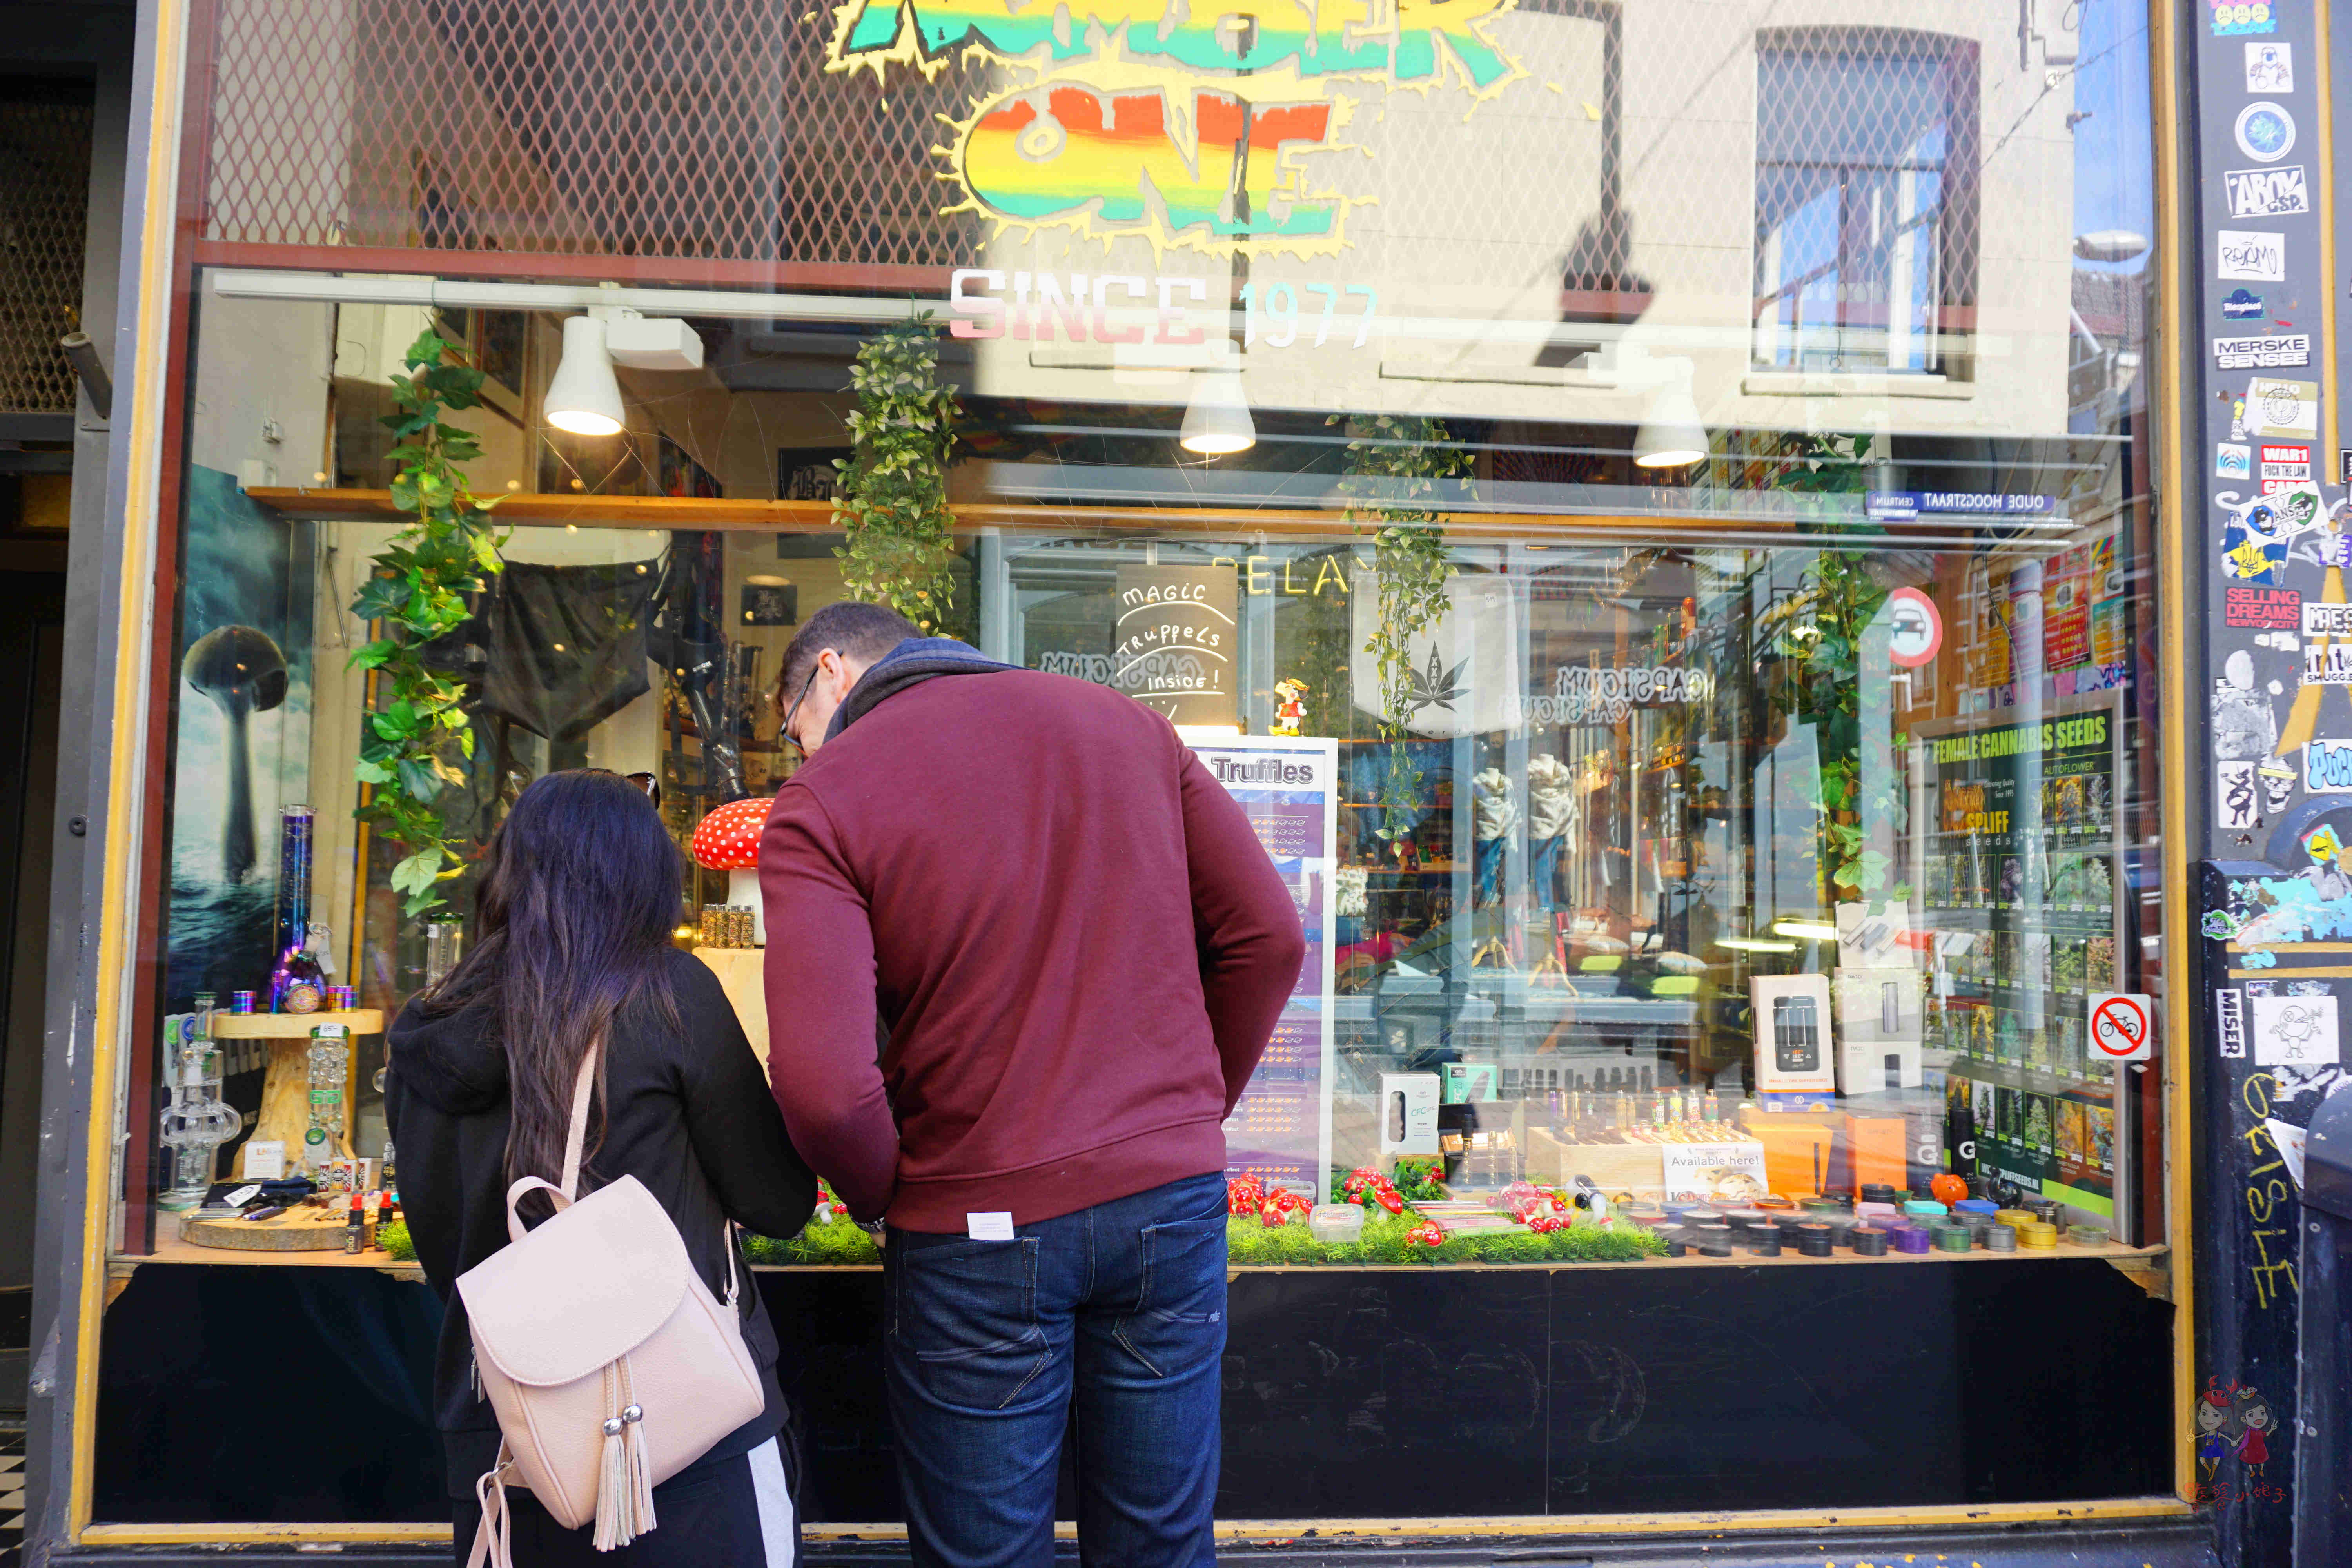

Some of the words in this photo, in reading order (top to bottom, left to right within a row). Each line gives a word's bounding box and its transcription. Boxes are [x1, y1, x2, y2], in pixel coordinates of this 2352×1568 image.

[965, 83, 1340, 238] ONE
[949, 268, 1207, 344] SINCE
[1238, 281, 1379, 350] 1977
[2218, 339, 2305, 352] MERSKE
[2218, 352, 2308, 368] SENSEE
[2265, 465, 2279, 476] FUCK
[2282, 465, 2292, 476] THE
[2294, 465, 2307, 477] LAW
[1122, 582, 1206, 606] MAGiC
[2226, 588, 2300, 605] SELLING
[2227, 604, 2300, 621] DREAMS
[1933, 735, 1978, 764] FEMALE
[1981, 724, 2054, 759] CANNABIS
[2056, 716, 2107, 749] SEEDS
[1212, 756, 1314, 784] Truffles
[2044, 762, 2094, 775] AUTOFLOWER
[1967, 811, 2009, 835] SPLIFF
[1966, 835, 2011, 846] seeds
[2223, 992, 2241, 1055] MISER
[1411, 1107, 1427, 1117] CFC
[1671, 1156, 1725, 1166] Available
[1729, 1156, 1759, 1165] here!
